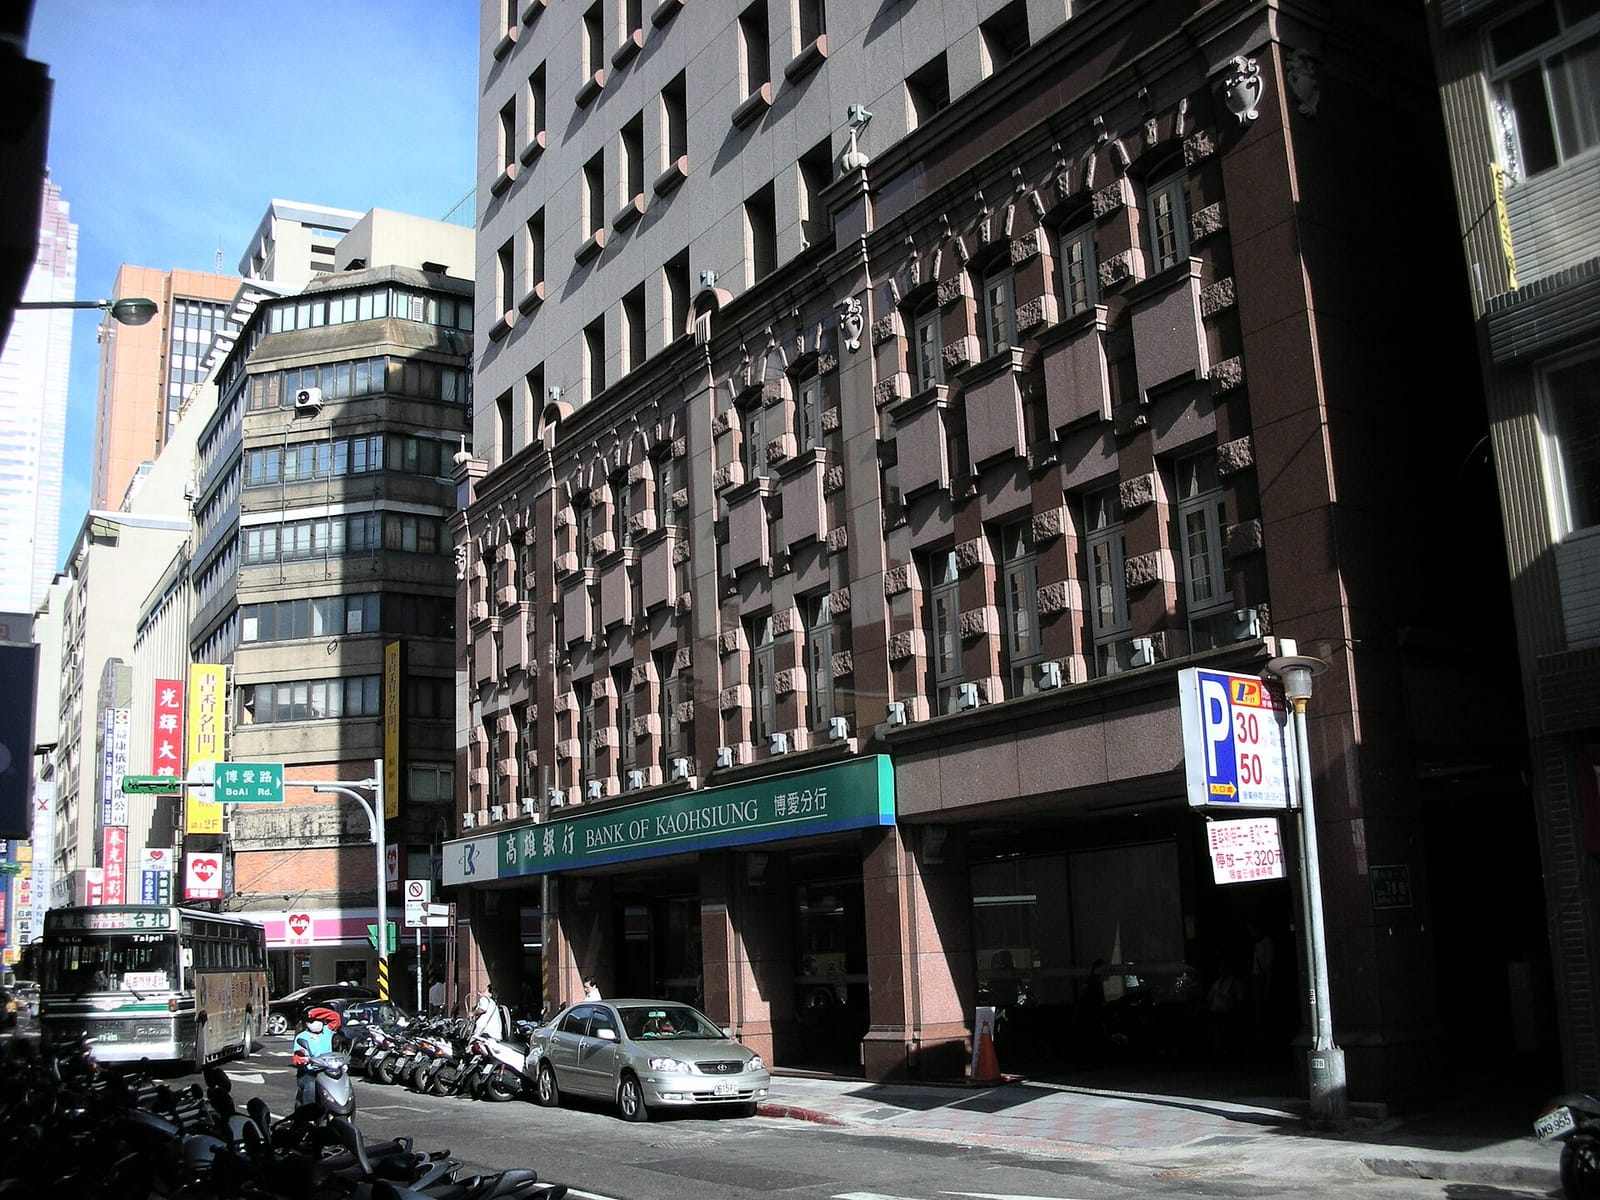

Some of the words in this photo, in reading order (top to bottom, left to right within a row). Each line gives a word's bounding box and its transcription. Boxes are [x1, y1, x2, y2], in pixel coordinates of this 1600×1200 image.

[198, 673, 216, 753] 書香名門
[1201, 680, 1230, 777] P
[1236, 712, 1259, 744] 30
[225, 769, 272, 784] 博愛路
[1240, 754, 1262, 785] 50
[257, 787, 272, 796] Rd.
[774, 787, 828, 817] 博愛分行
[585, 823, 624, 848] BANK
[629, 818, 649, 841] OF
[656, 799, 759, 836] KAOHSIUNG
[506, 823, 575, 865] 高雄銀行
[133, 912, 165, 928] 台北
[132, 934, 164, 943] Taipei
